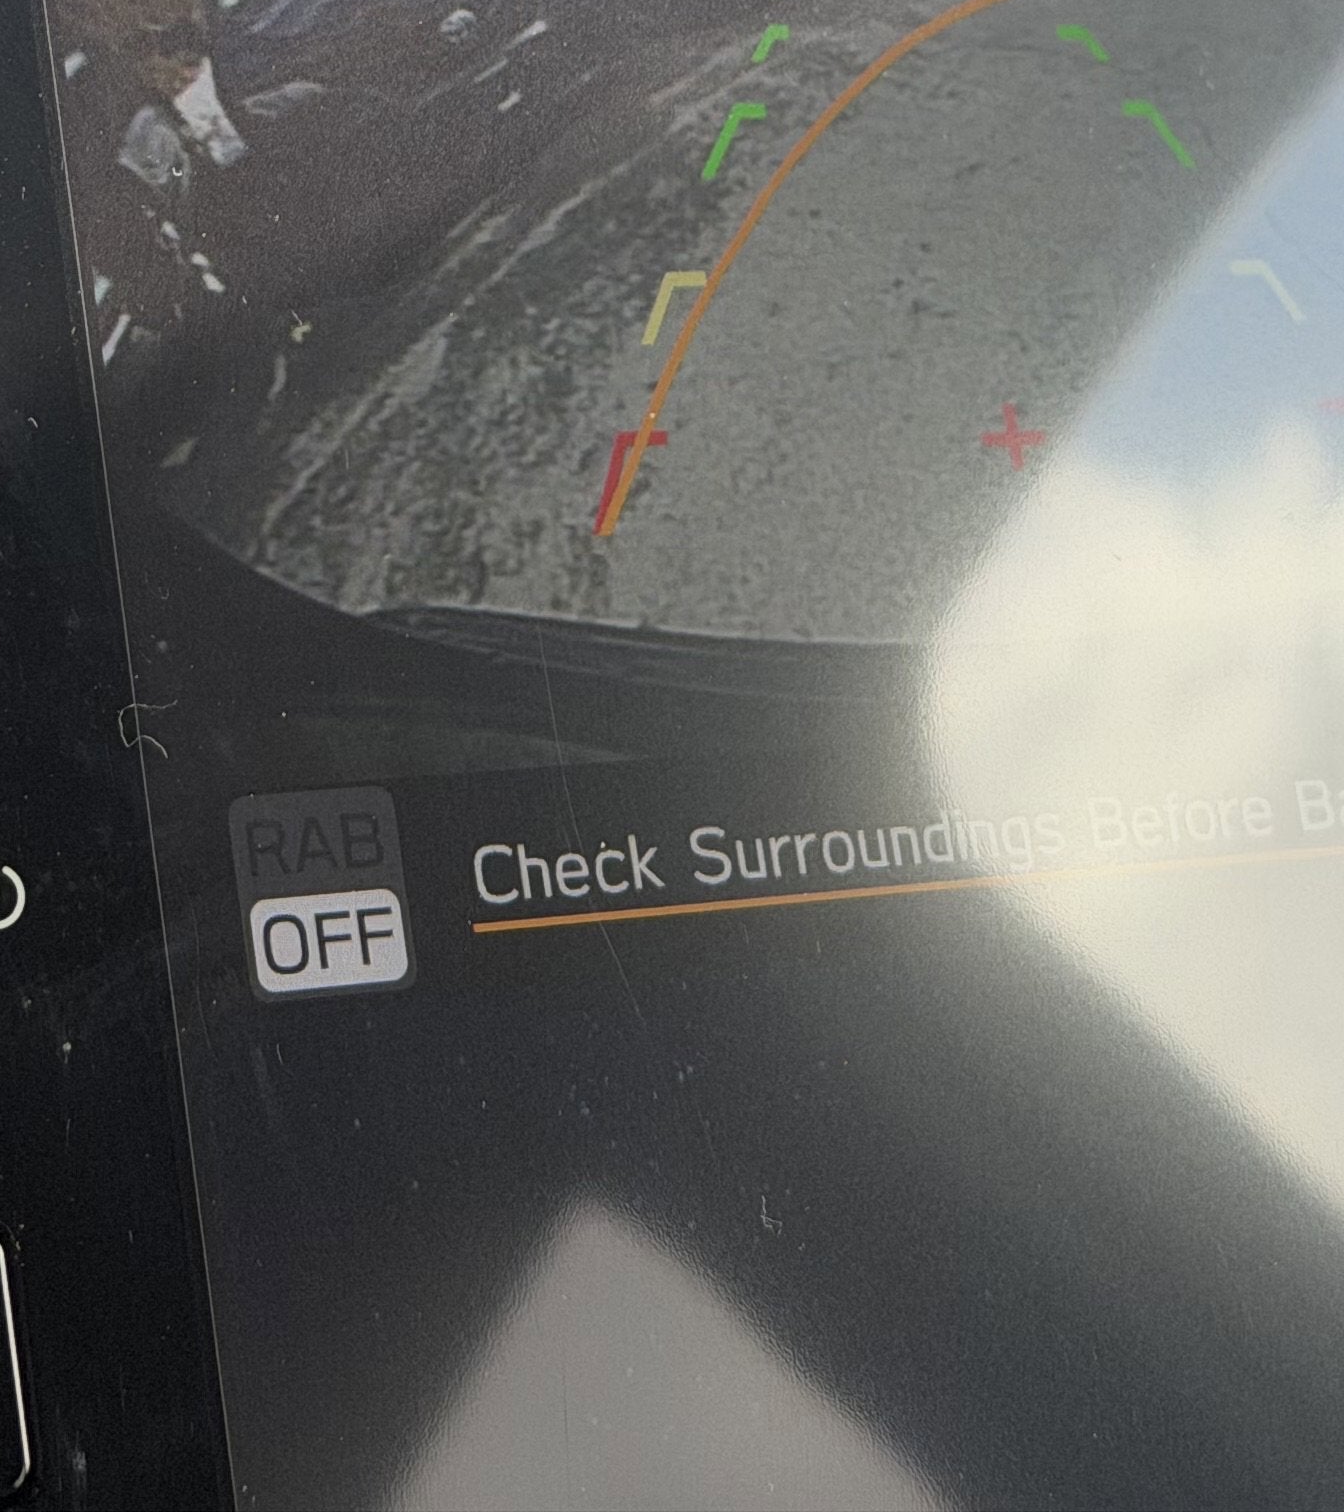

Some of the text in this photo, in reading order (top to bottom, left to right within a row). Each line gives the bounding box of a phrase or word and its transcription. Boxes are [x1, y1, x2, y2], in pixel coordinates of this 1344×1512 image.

[245, 812, 384, 877] RAB
[473, 834, 665, 905] Check
[689, 808, 1064, 884] Surroundings
[1087, 791, 1272, 851] Before
[260, 906, 395, 975] OFF
